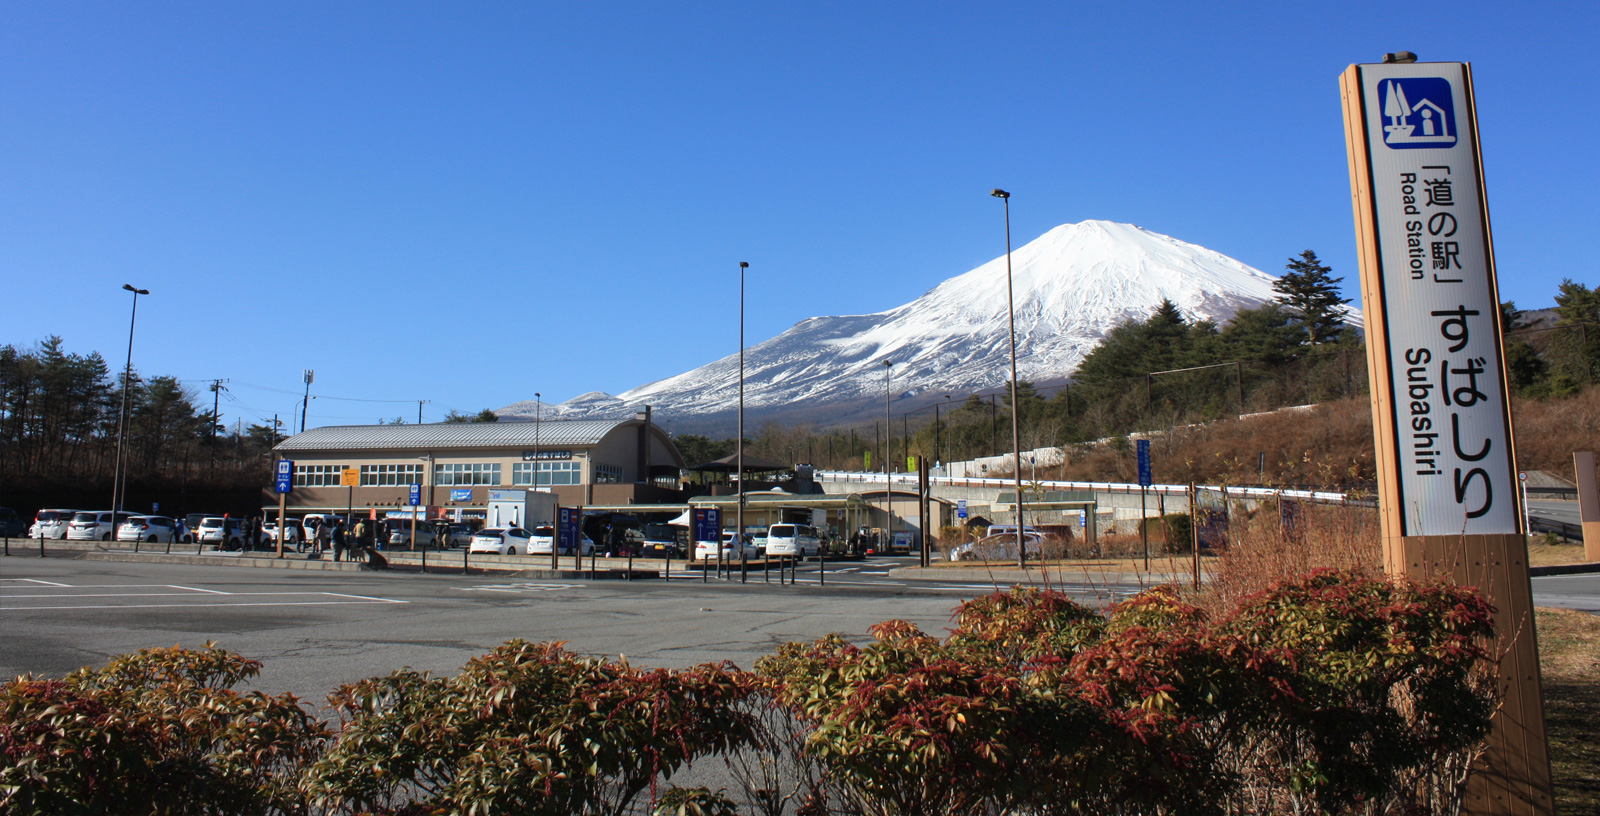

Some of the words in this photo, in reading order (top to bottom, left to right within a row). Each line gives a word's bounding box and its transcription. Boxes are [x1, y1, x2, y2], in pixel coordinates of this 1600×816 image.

[1400, 172, 1421, 215] Road
[1405, 220, 1426, 280] Station
[1405, 347, 1442, 476] Subashiri
[1430, 304, 1493, 519] すばしり
